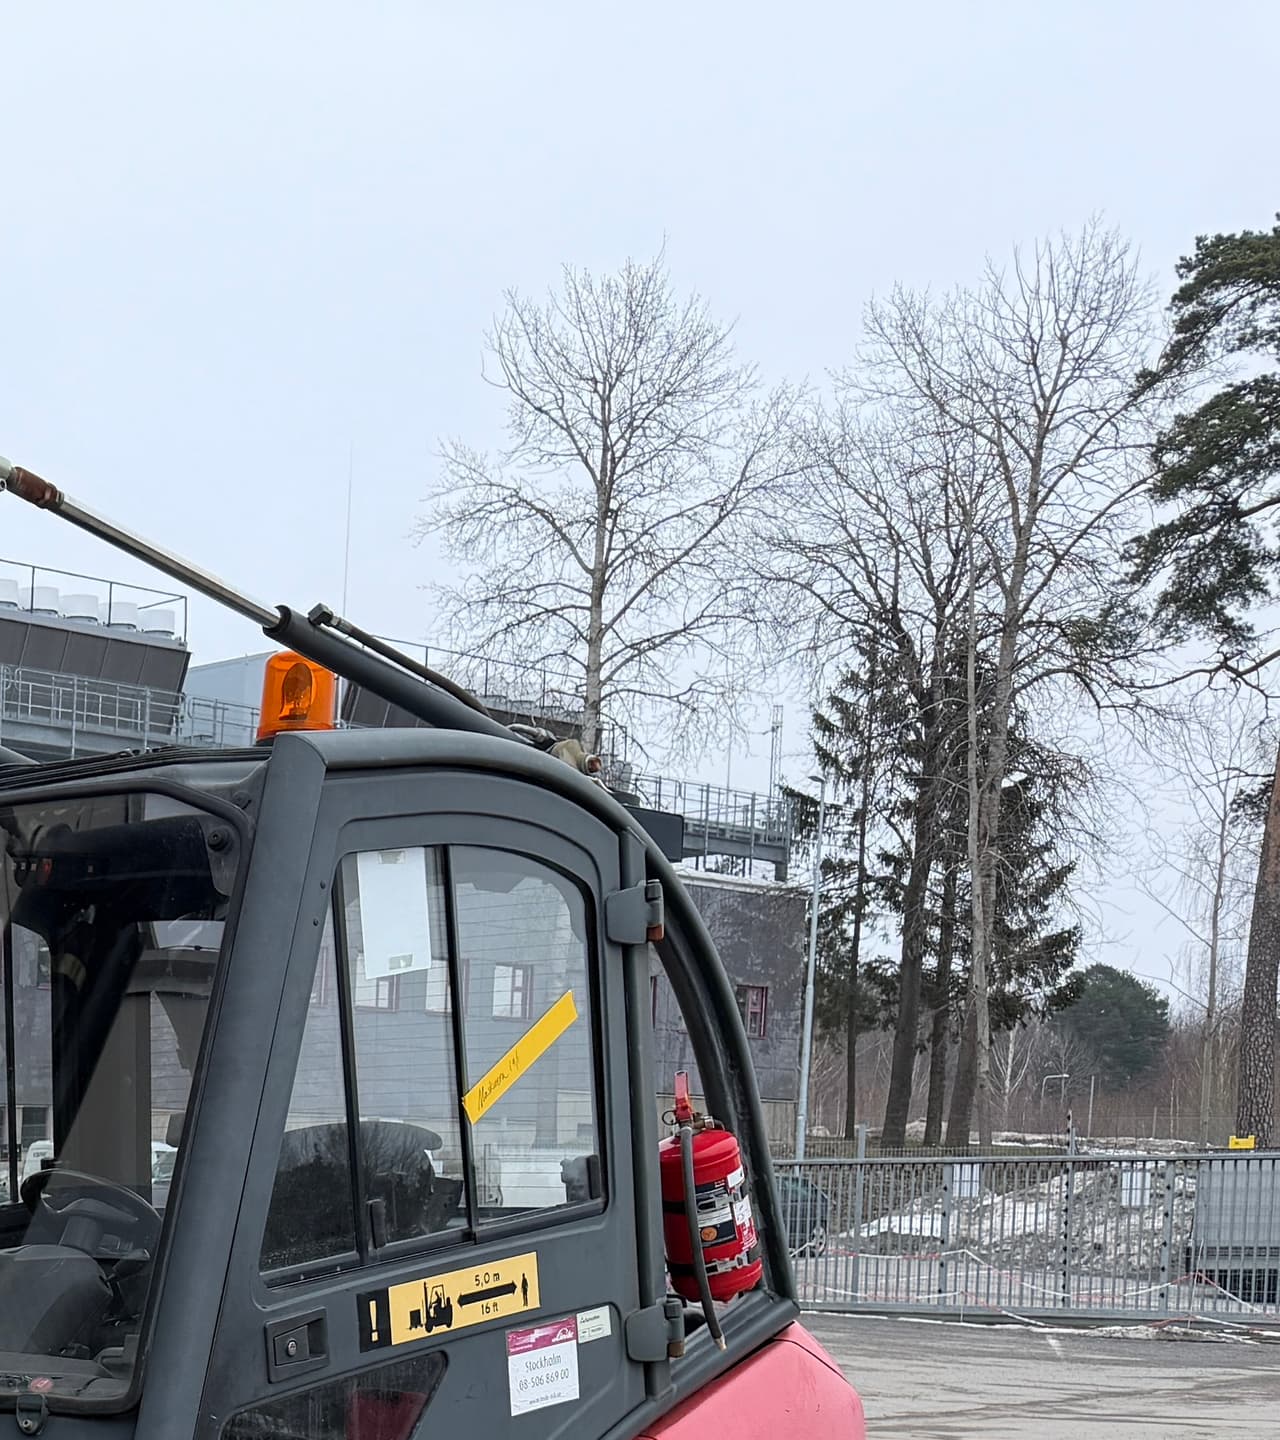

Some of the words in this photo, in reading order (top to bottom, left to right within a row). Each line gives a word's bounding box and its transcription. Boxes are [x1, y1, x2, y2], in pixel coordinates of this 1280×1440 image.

[474, 1272, 490, 1288] 5,0
[492, 1272, 500, 1282] m
[481, 1303, 491, 1315] 16
[525, 1353, 562, 1373] Stockholm
